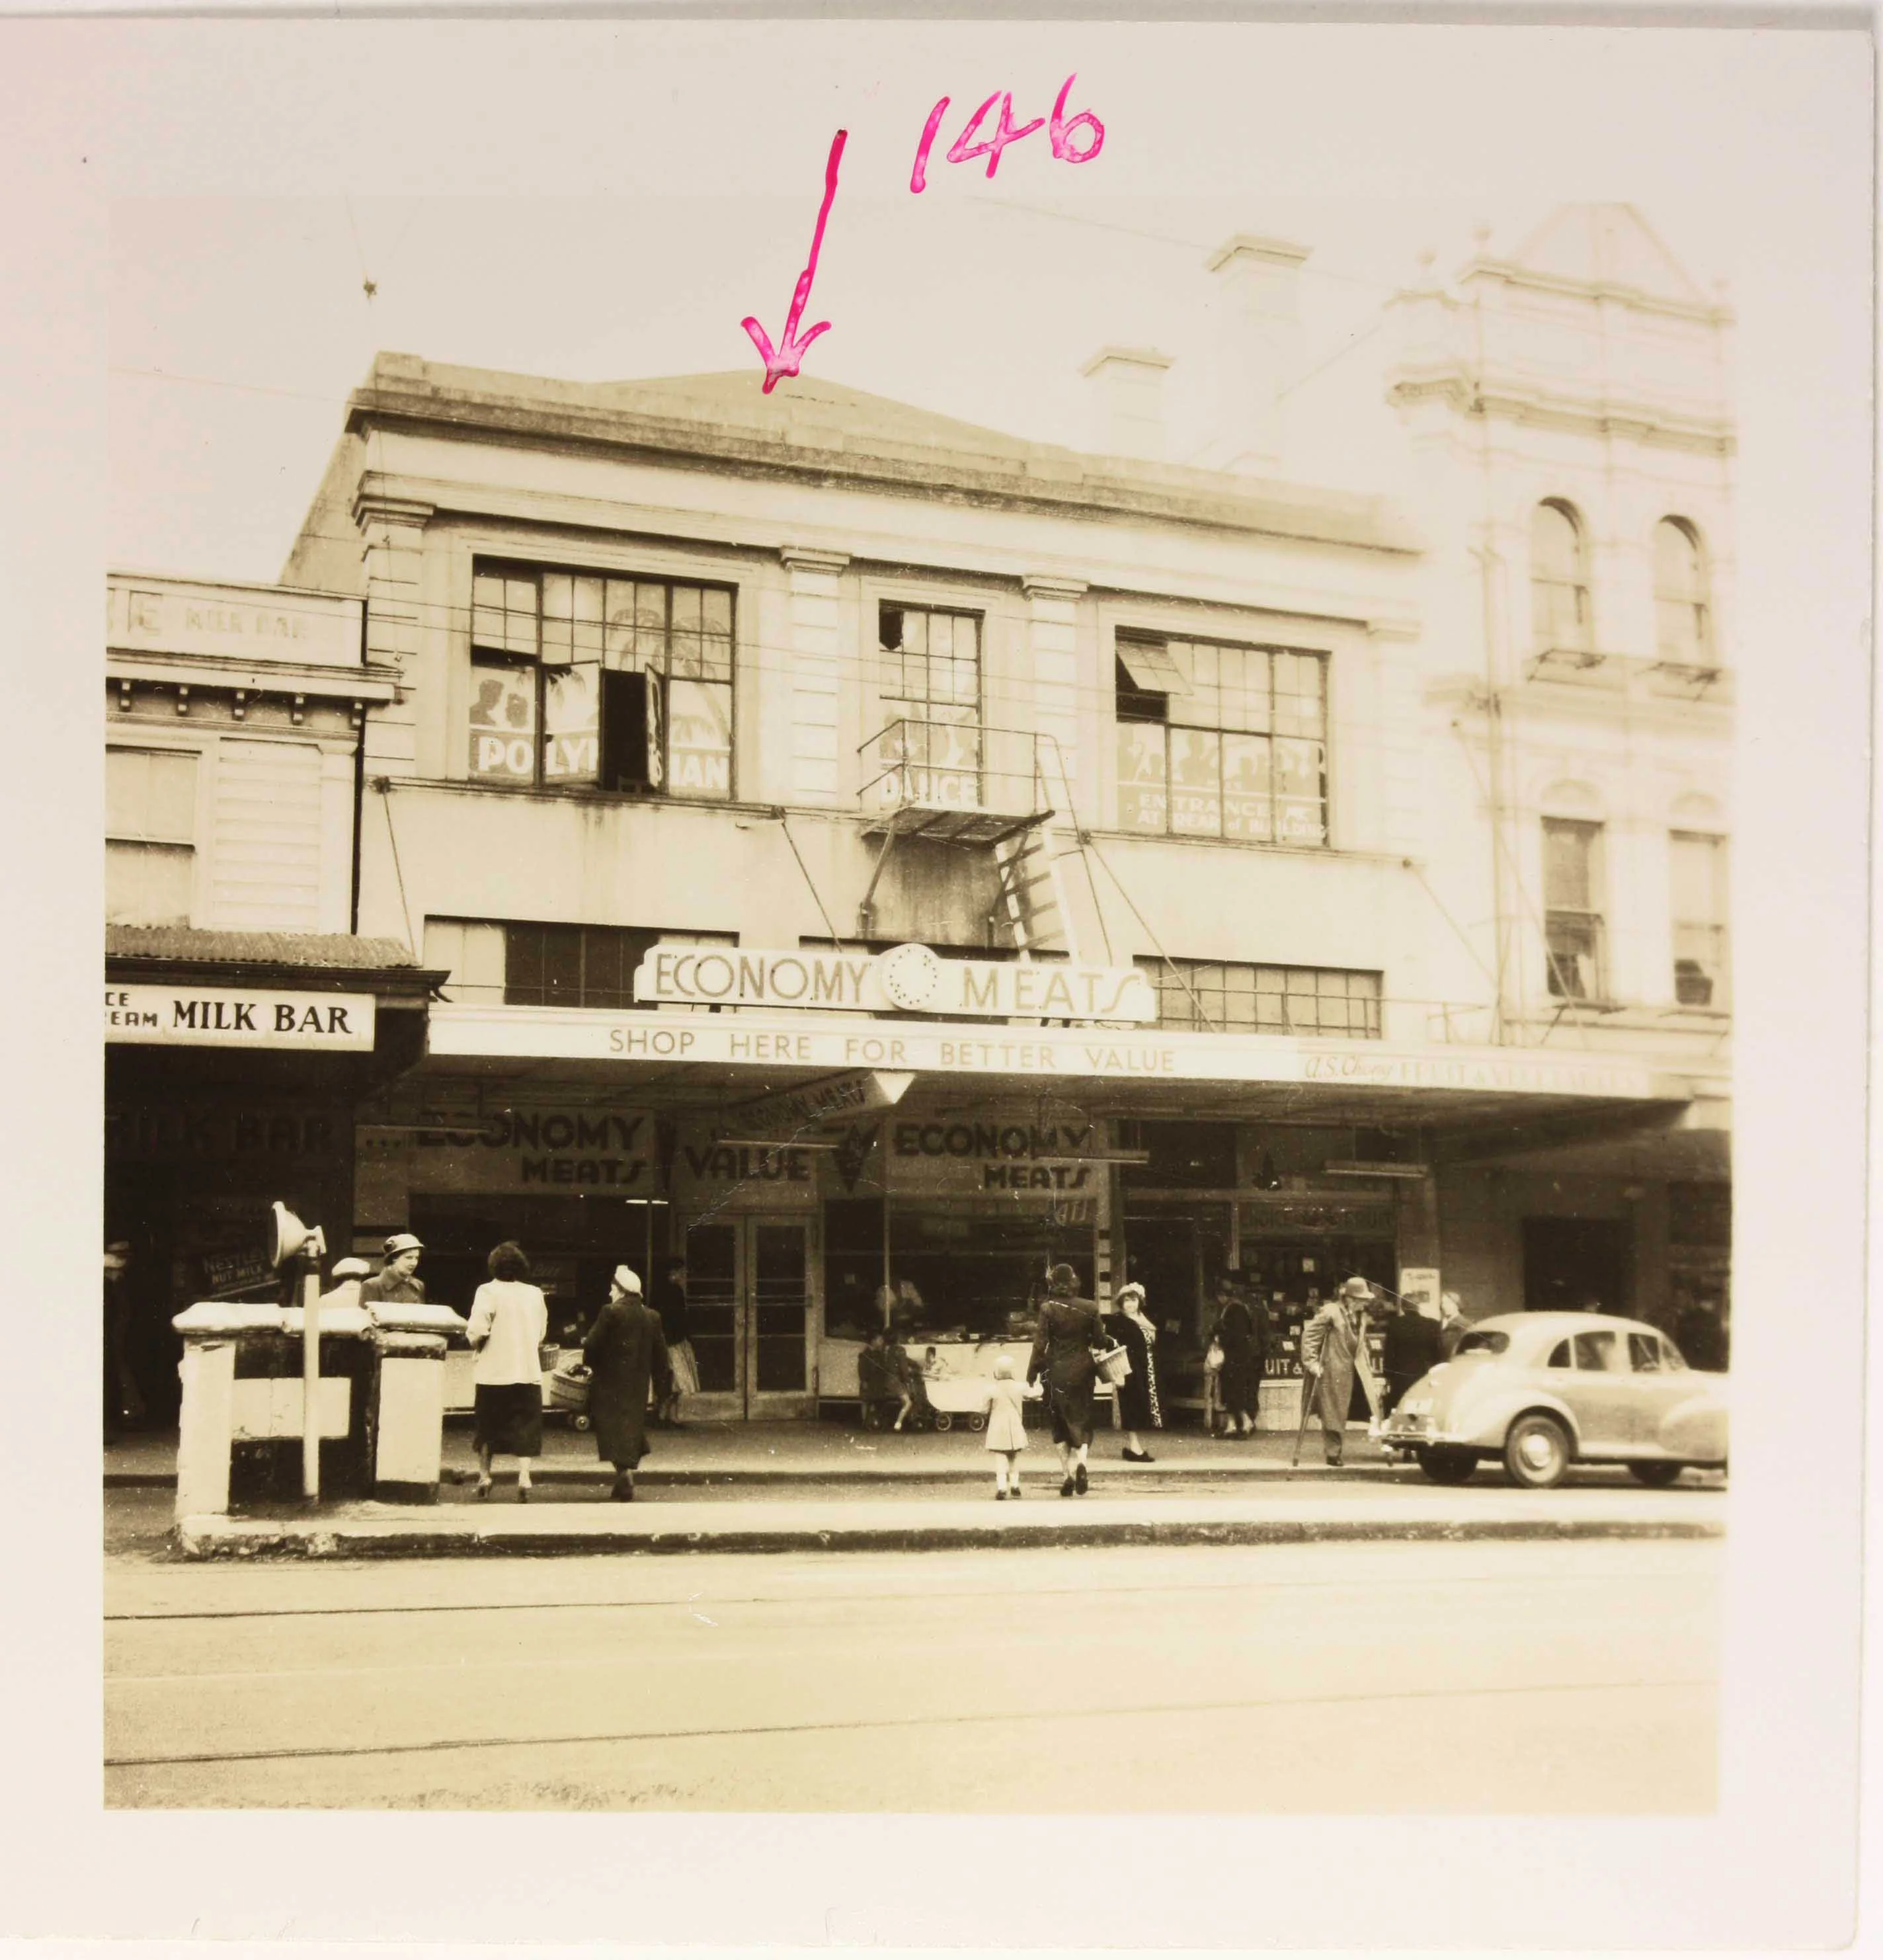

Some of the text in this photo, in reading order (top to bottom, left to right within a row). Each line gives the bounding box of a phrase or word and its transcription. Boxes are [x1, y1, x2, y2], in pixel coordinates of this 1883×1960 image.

[910, 72, 1105, 194] 146
[656, 953, 1142, 1014] ECONOMY MEATS
[104, 1010, 158, 1028] EAM
[173, 1000, 352, 1034] MILK BAR
[609, 1029, 1176, 1073] SHOP HERE FOR BETTER VALUE
[417, 1110, 646, 1151] ECONOMY
[895, 1123, 1092, 1159] ECONOMY
[522, 1156, 646, 1184] MEATS
[684, 1146, 811, 1182] VALUE
[984, 1163, 1091, 1190] MEATS
